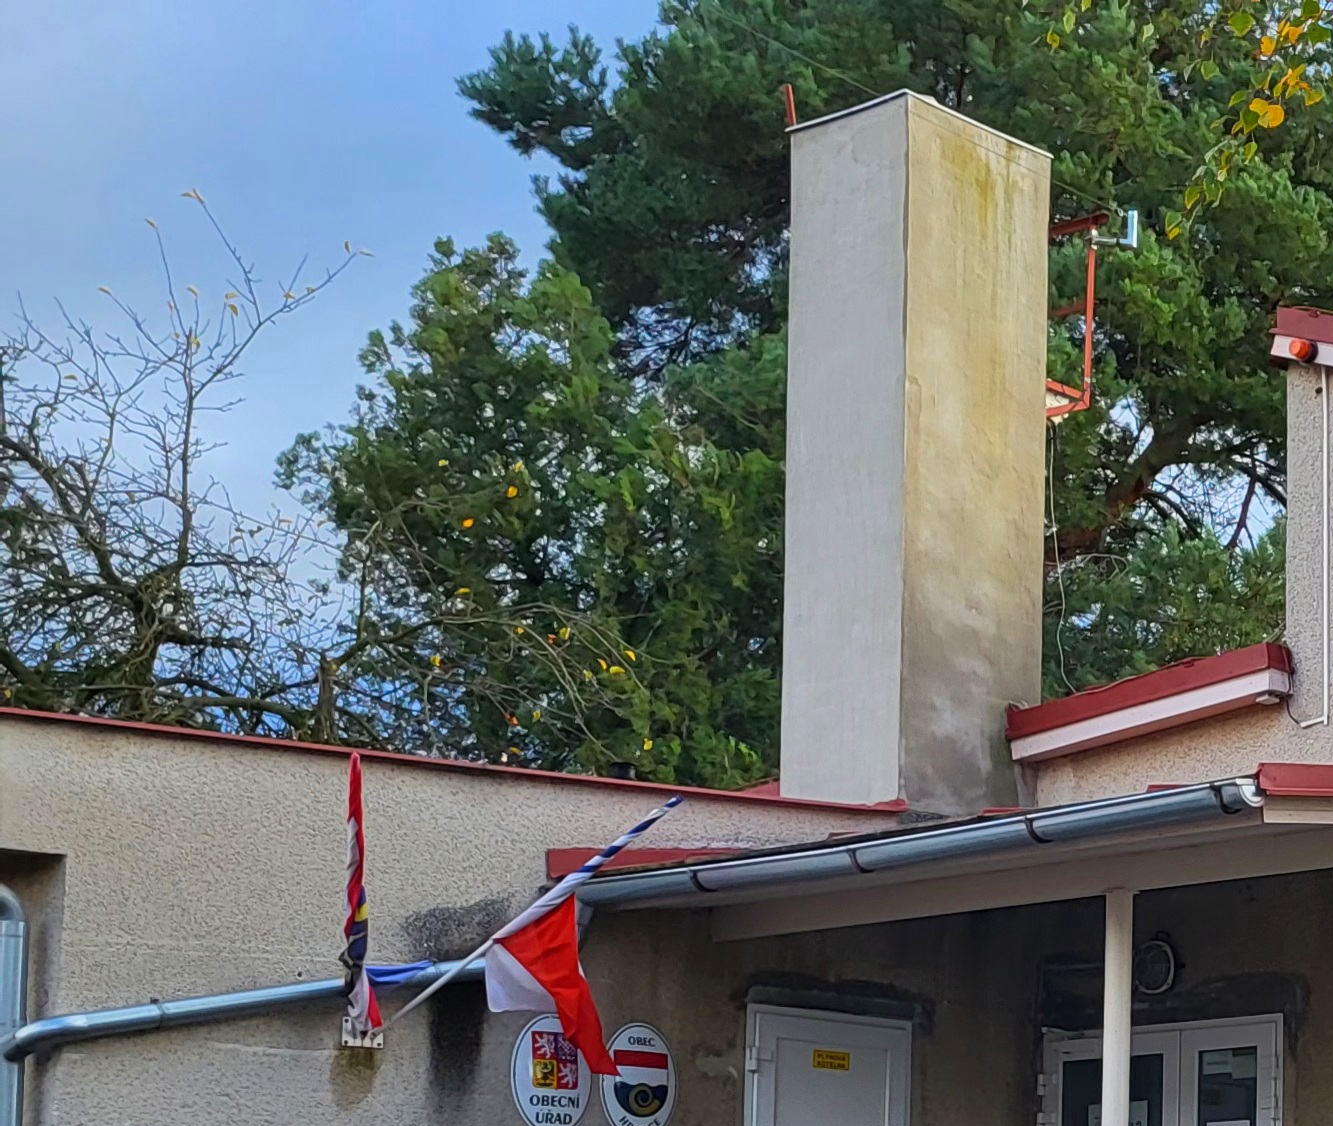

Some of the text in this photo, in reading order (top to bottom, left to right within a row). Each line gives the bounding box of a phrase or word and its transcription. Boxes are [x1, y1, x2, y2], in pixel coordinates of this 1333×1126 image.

[627, 1035, 656, 1048] OBEC
[529, 1093, 580, 1109] OBECNÍ
[535, 1108, 573, 1125] ÚŘAD
